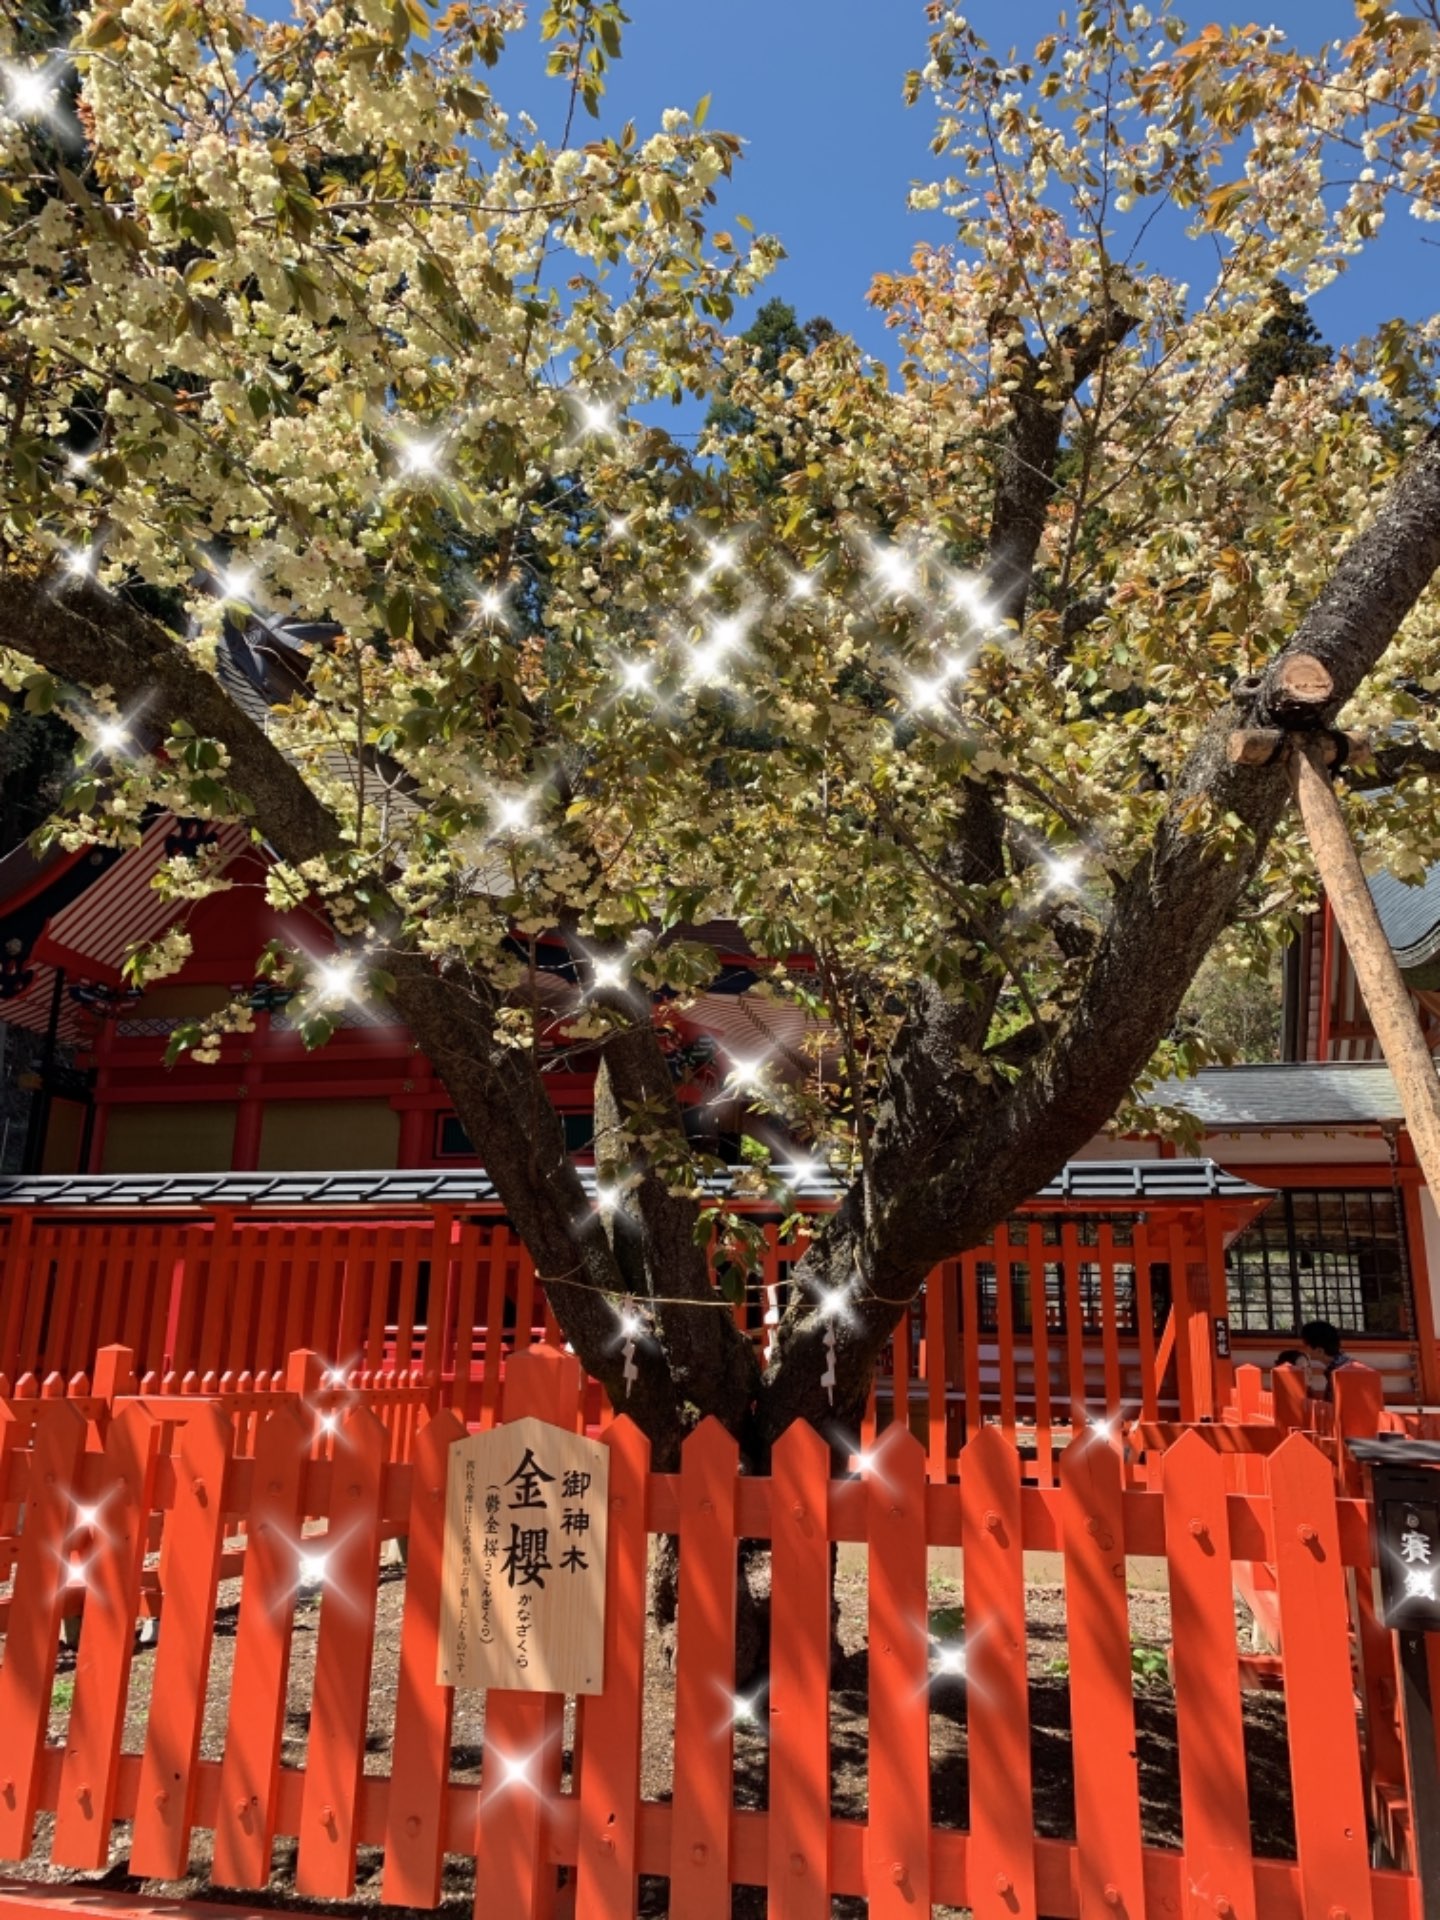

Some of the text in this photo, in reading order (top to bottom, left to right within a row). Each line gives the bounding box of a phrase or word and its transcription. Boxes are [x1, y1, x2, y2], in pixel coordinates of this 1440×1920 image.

[500, 1447, 557, 1590] 金櫻
[560, 1469, 591, 1574] 御神木
